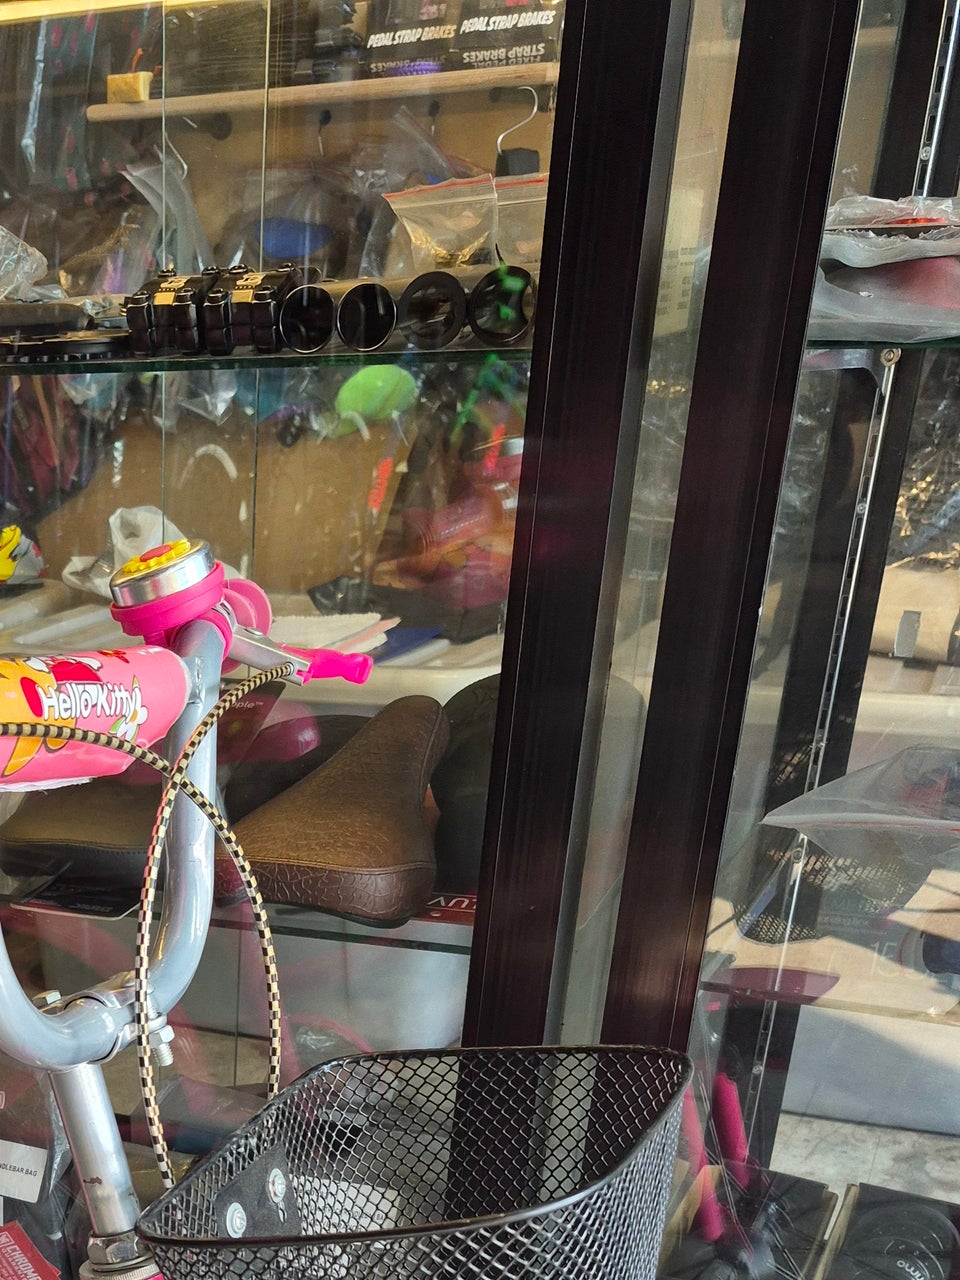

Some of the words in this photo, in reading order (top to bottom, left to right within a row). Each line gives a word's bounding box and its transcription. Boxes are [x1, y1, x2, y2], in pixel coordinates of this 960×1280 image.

[460, 17, 487, 34] PEDAL
[487, 14, 517, 31] STRAP
[517, 10, 556, 28] BRAKES
[367, 33, 393, 48] PEDAL
[393, 29, 421, 45] STRAP
[421, 25, 457, 41] BRAKES
[463, 47, 506, 64] BRAKES
[507, 43, 545, 60] STRAP
[36, 681, 90, 721] Hello
[96, 682, 141, 721] Kitty
[24, 1169, 38, 1177] BAG
